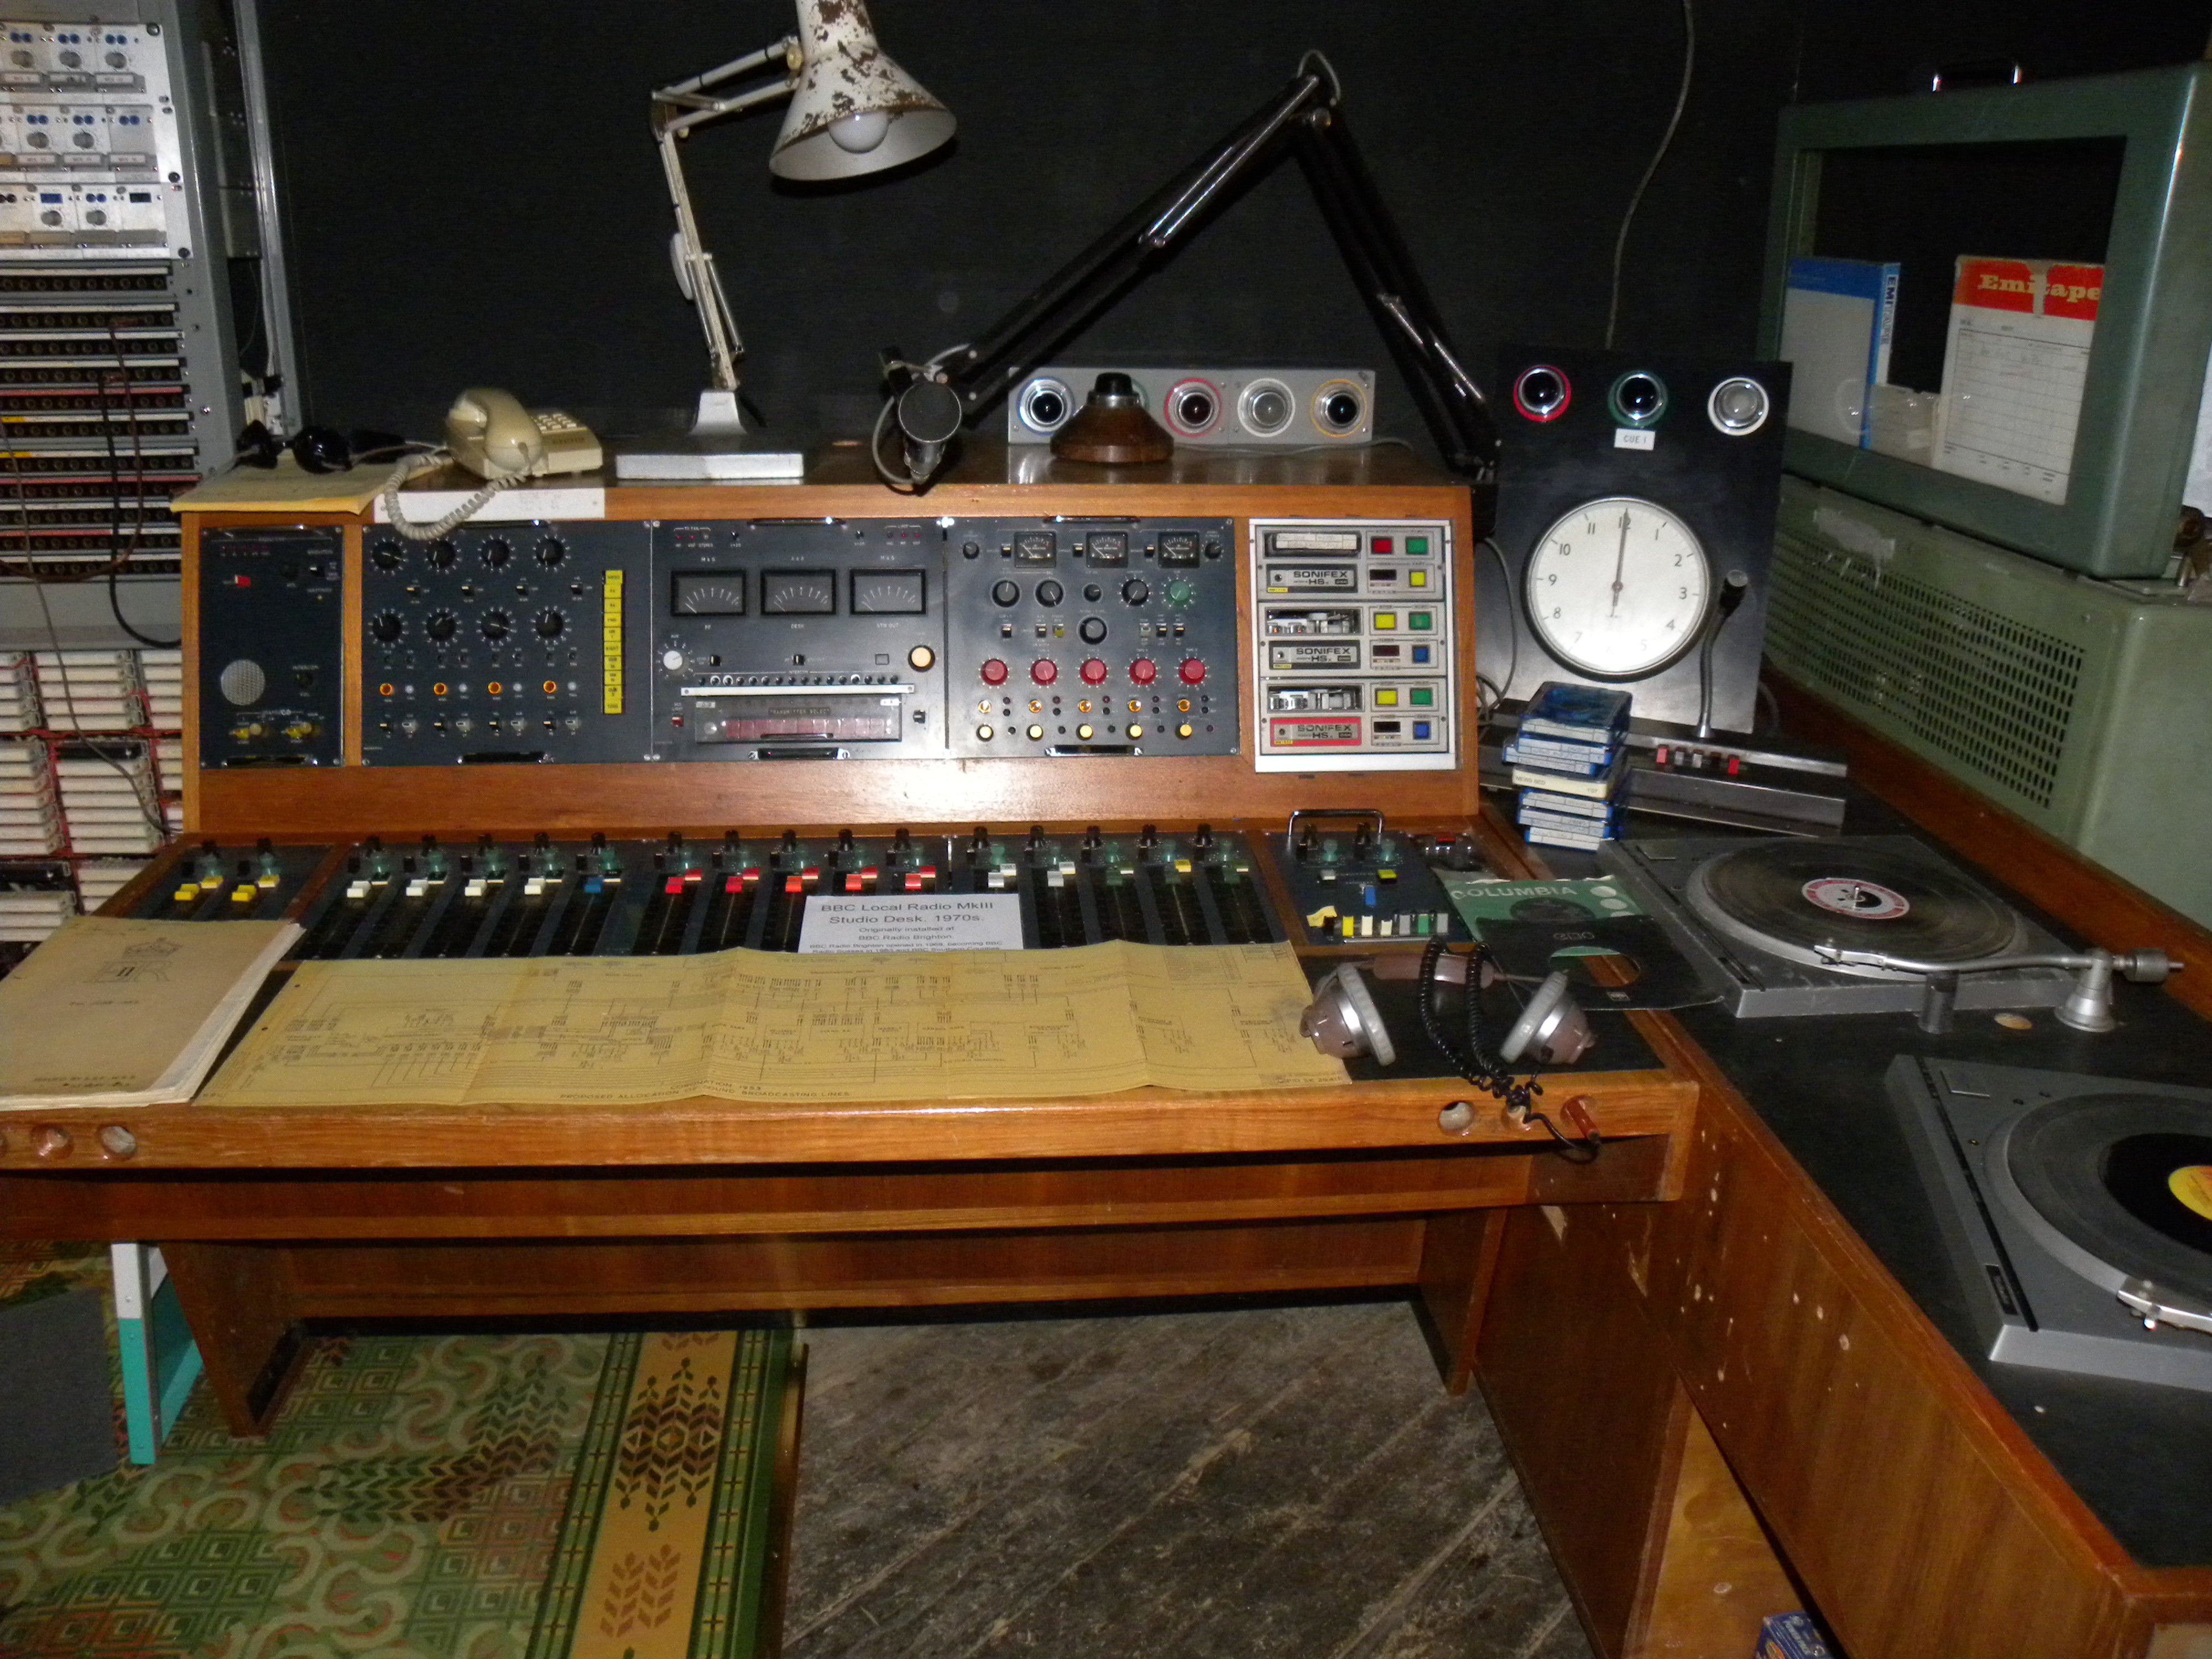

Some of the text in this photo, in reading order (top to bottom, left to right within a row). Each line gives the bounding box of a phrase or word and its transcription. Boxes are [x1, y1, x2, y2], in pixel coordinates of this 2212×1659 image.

[1978, 274, 2101, 303] Emiape
[1588, 522, 1595, 535] 11
[1655, 529, 1659, 541] 1
[1559, 543, 1571, 556] 10
[1673, 554, 1682, 567] 2
[1548, 573, 1557, 586] 9
[1679, 587, 1688, 599] 3
[1553, 606, 1562, 619] 8
[1666, 619, 1676, 631] 4
[1574, 632, 1583, 644] 7
[1639, 639, 1648, 651] 5
[1451, 886, 1578, 900] COLUMBIA
[830, 916, 879, 924] Studio
[935, 914, 984, 922] 1970s.
[670, 1079, 733, 1089] CORONATION
[617, 1091, 680, 1099] ALLOCATION
